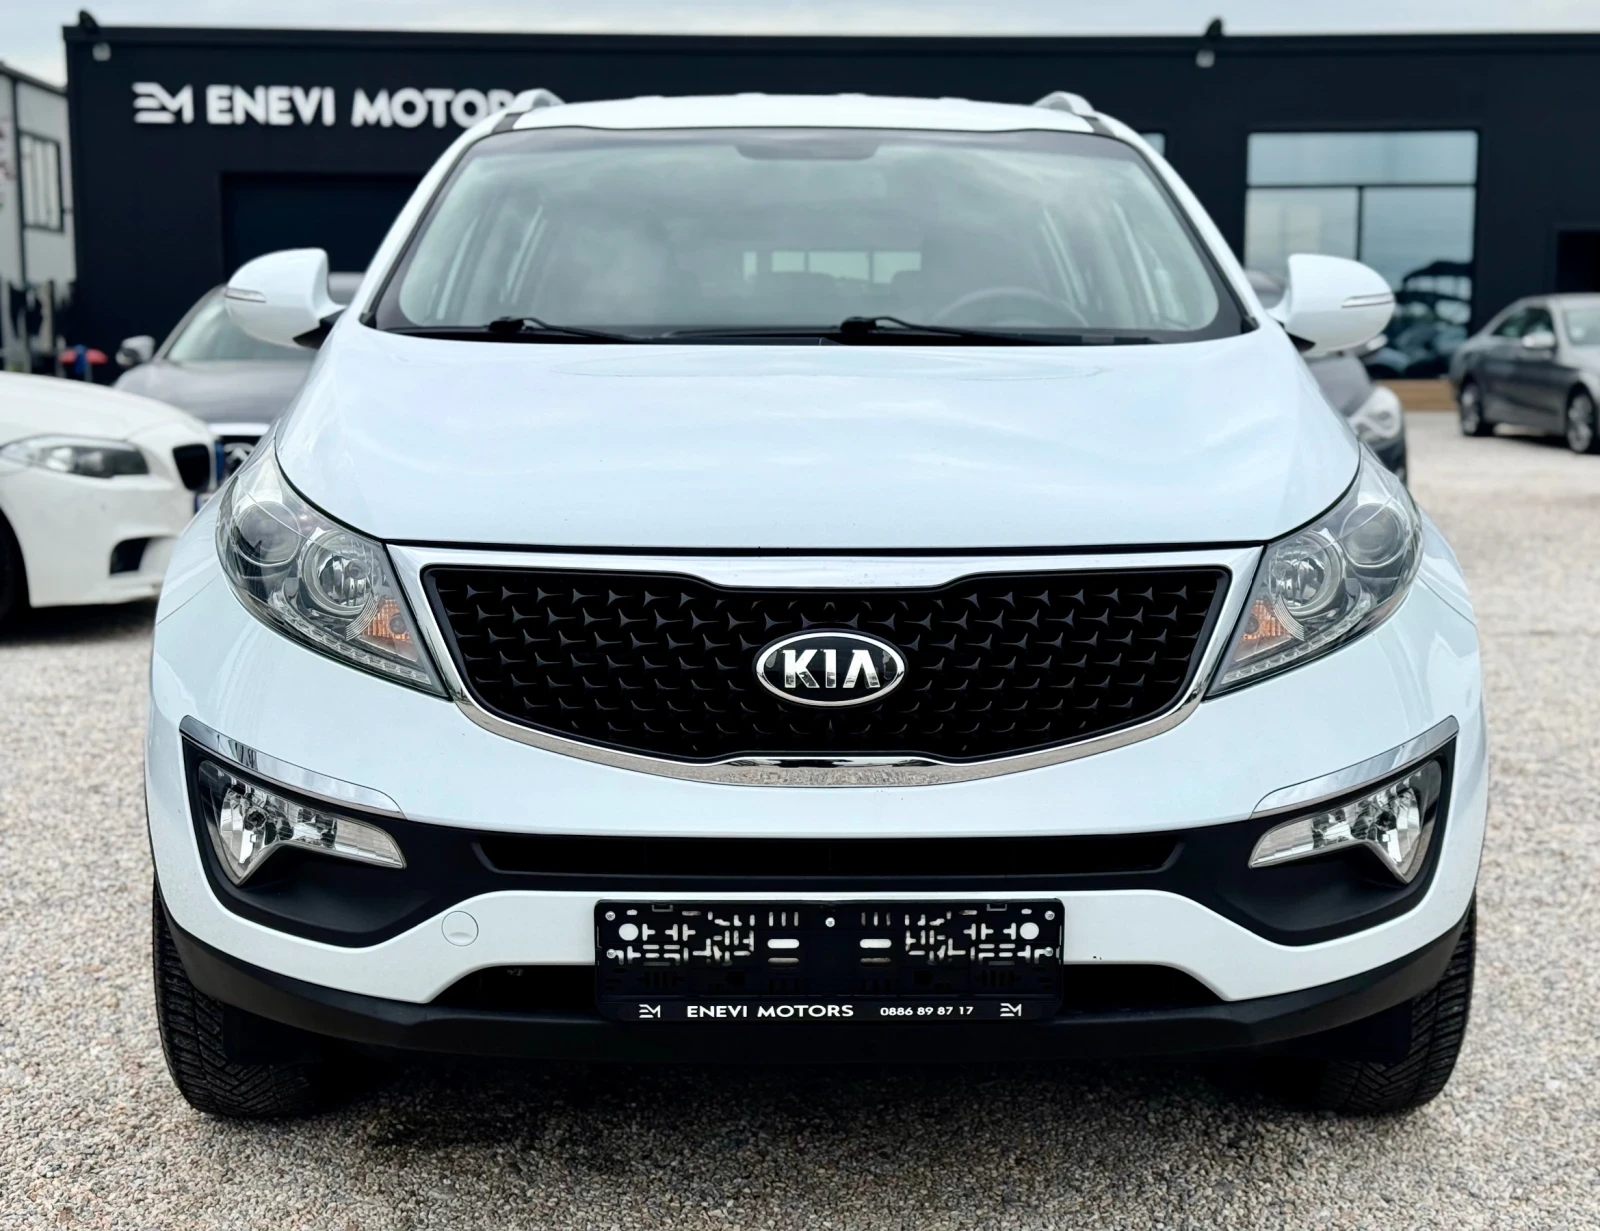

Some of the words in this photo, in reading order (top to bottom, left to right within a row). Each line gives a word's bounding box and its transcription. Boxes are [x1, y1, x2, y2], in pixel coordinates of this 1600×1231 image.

[206, 84, 336, 126] ENEVI
[351, 88, 517, 128] MOTOR
[781, 649, 881, 688] KIA
[686, 1005, 748, 1018] ENEVI
[757, 1004, 854, 1018] MOTORS
[880, 1006, 914, 1016] 0886
[916, 1006, 934, 1016] 89
[936, 1006, 954, 1016] 87
[958, 1006, 974, 1015] 17
